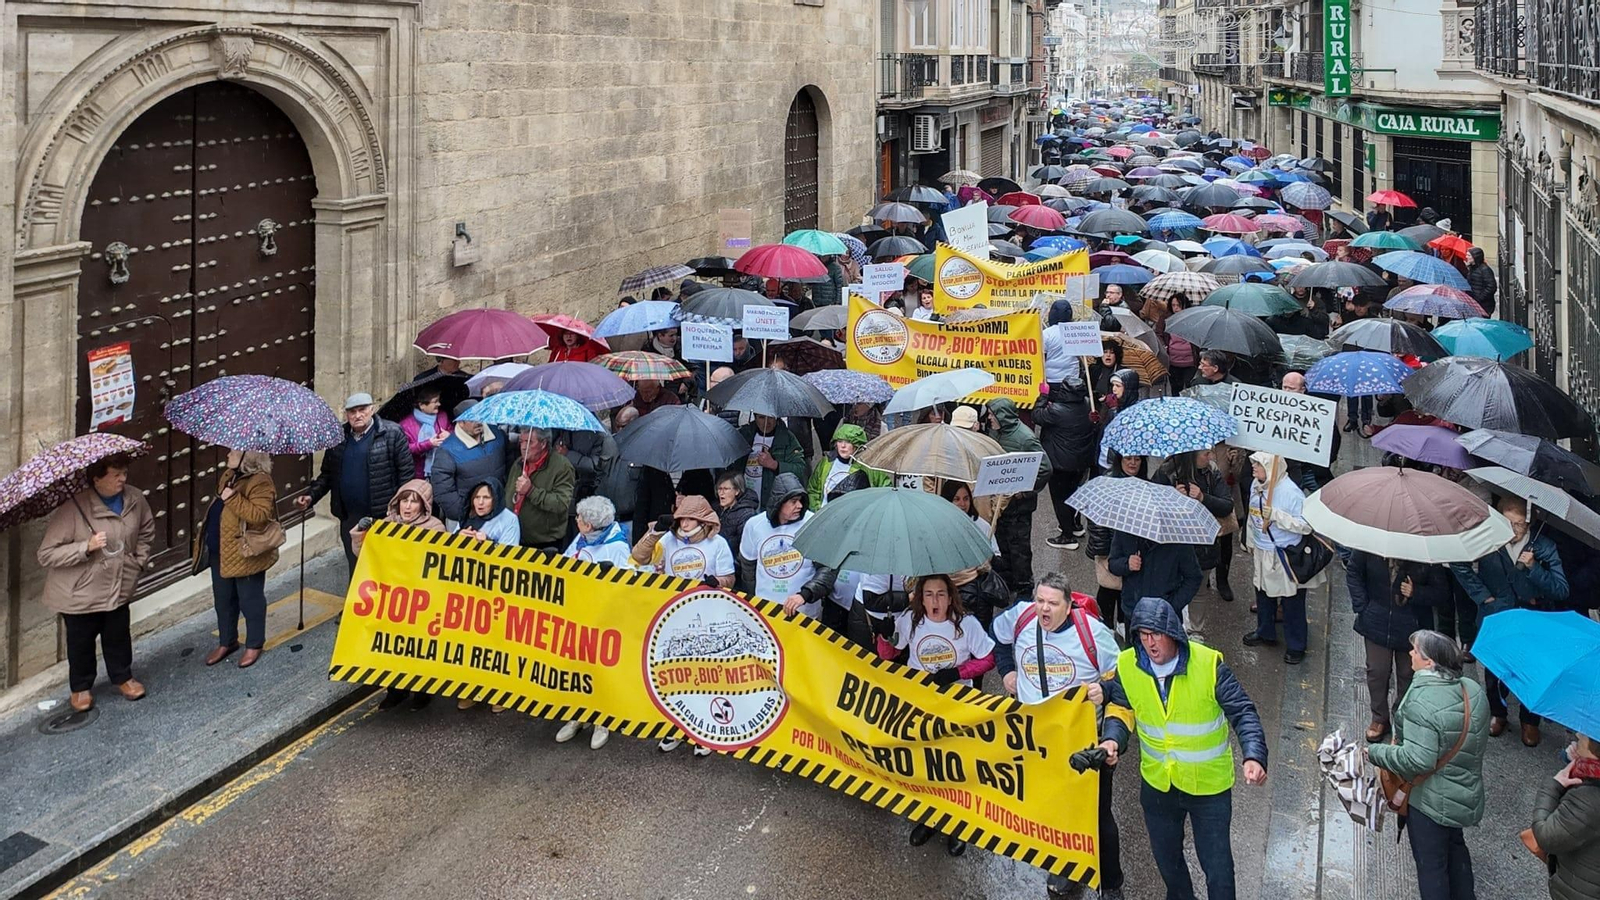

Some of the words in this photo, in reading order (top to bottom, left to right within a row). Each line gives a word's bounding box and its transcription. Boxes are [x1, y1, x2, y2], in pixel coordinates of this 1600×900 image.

[1329, 5, 1347, 94] RURAL
[1378, 114, 1416, 131] CAJA
[1420, 116, 1480, 135] RURAL
[912, 332, 947, 351] STOP
[979, 337, 1038, 356] METANO
[916, 355, 948, 368] ALCALA
[951, 358, 961, 369] LA
[998, 358, 1032, 370] ALDEAS
[1005, 373, 1016, 384] NO
[1018, 372, 1033, 386] ASÍ
[1231, 383, 1330, 416] ¡ORGULLOSXS
[1233, 405, 1253, 418] DE
[1256, 406, 1321, 431] RESPIRAR
[1242, 419, 1266, 434] TU
[986, 458, 1011, 467] SALUD
[1012, 456, 1037, 464] ANTES
[1000, 467, 1018, 476] QUE
[988, 475, 1024, 485] NEGOCIO
[422, 551, 565, 607] PLATAFORMA
[353, 579, 430, 625] STOP
[505, 606, 622, 667] METANO
[371, 630, 438, 661] ALCALA
[443, 641, 465, 666] LA
[470, 645, 510, 676] REAL
[517, 656, 527, 679] Y
[530, 660, 593, 695] ALDEAS
[658, 666, 692, 687] STOP
[674, 699, 704, 729] ALCALÁ
[706, 722, 717, 734] LA
[720, 724, 740, 736] REAL
[741, 723, 747, 733] Y
[748, 696, 776, 729] ALDEAS
[836, 671, 996, 743] BIOMETANO
[840, 729, 914, 778] PERO
[923, 747, 967, 783] NO
[976, 755, 1024, 802] ASÍ
[792, 728, 815, 750] POR
[818, 736, 832, 756] UN
[895, 780, 972, 810] PROXIMIDAD
[975, 794, 982, 815] Y
[984, 800, 1095, 857] AUTOSUFICIENCIA
